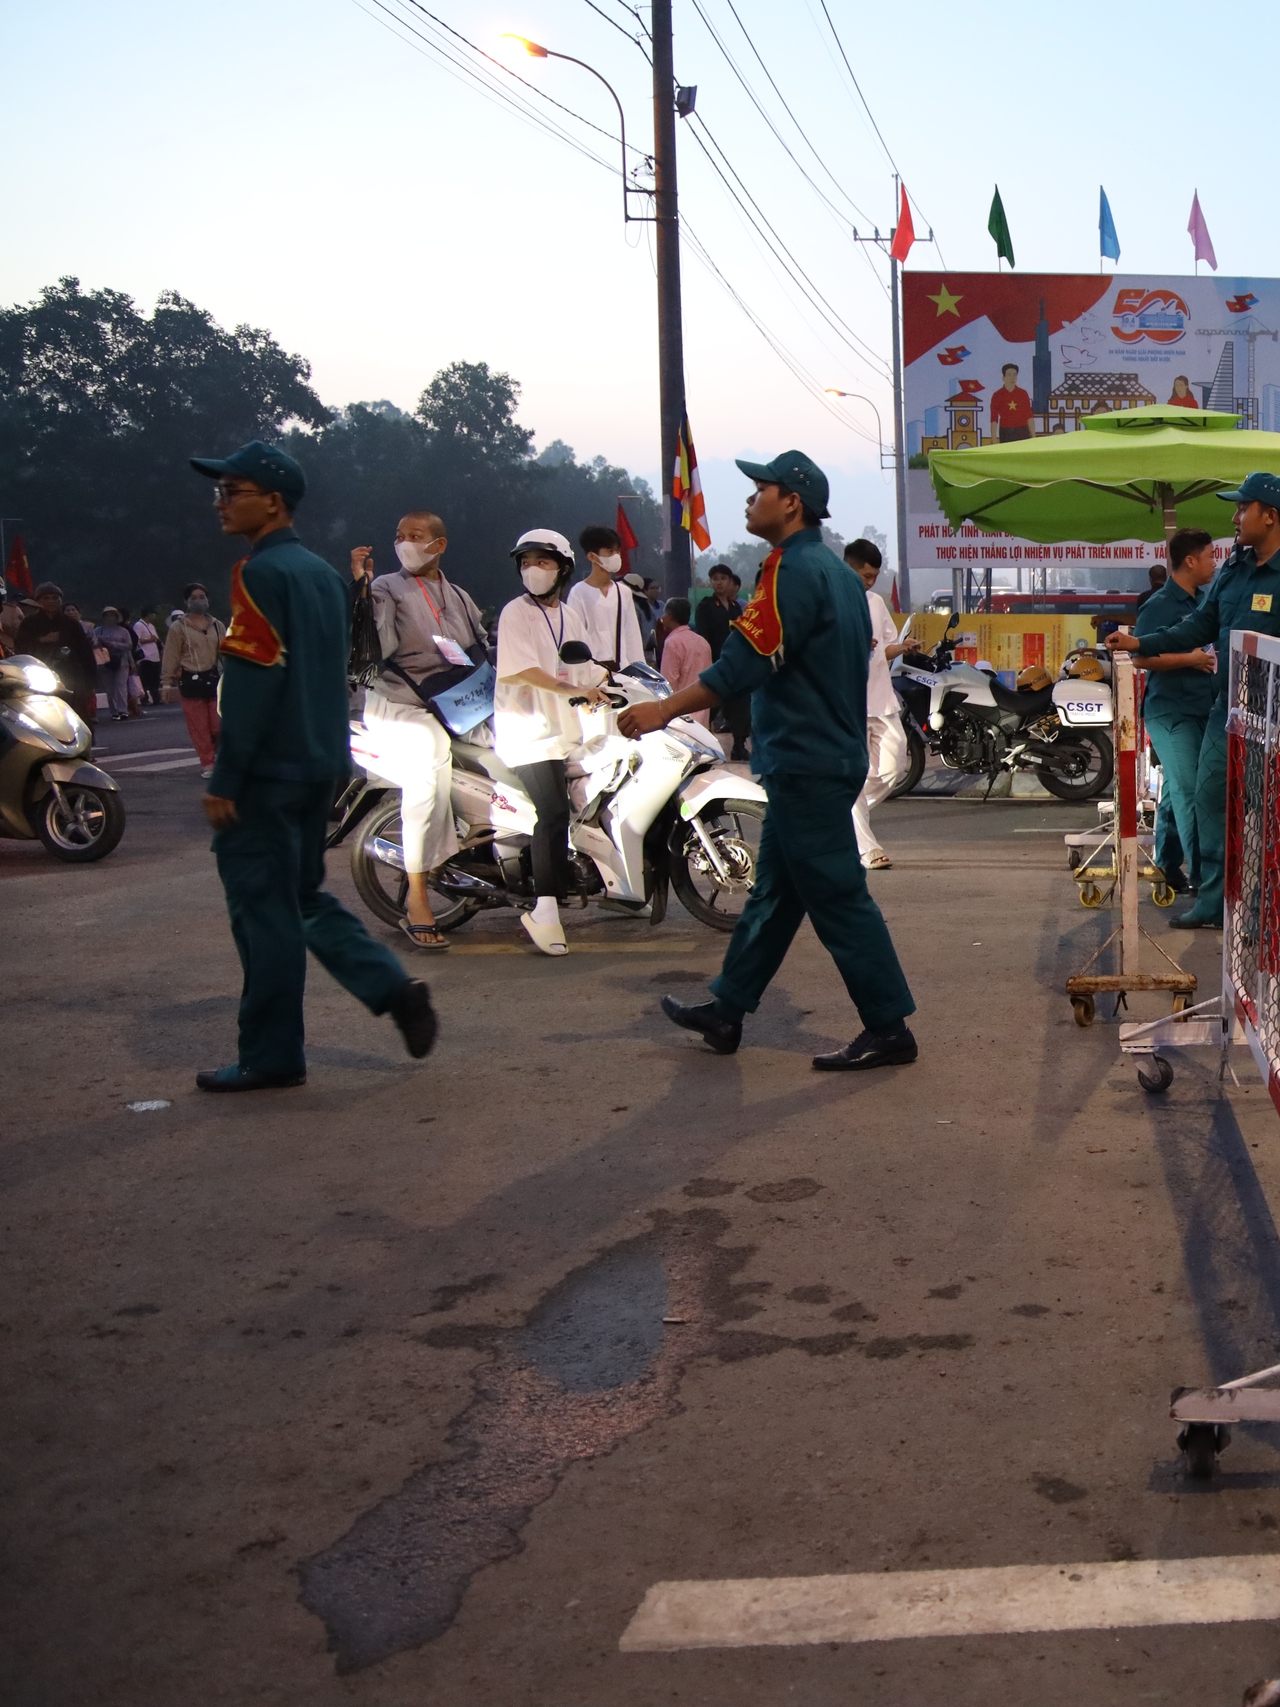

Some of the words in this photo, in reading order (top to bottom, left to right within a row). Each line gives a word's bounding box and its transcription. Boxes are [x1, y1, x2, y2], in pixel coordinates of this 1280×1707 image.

[919, 523, 940, 538] PHÁT
[942, 525, 957, 538] HU
[936, 545, 957, 562] THỰC
[959, 544, 979, 562] HIỆN
[981, 542, 1007, 559] THẮNG
[1009, 545, 1022, 562] LỢI
[1024, 544, 1051, 562] NHIỆM
[1053, 546, 1063, 562] VỤ
[1065, 543, 1086, 559] PHÁT
[1088, 543, 1112, 559] TRIỂN
[1113, 546, 1133, 559] KINH
[1135, 542, 1144, 559] TẾ
[1213, 545, 1223, 562] ỘI
[916, 675, 938, 686] CSGT
